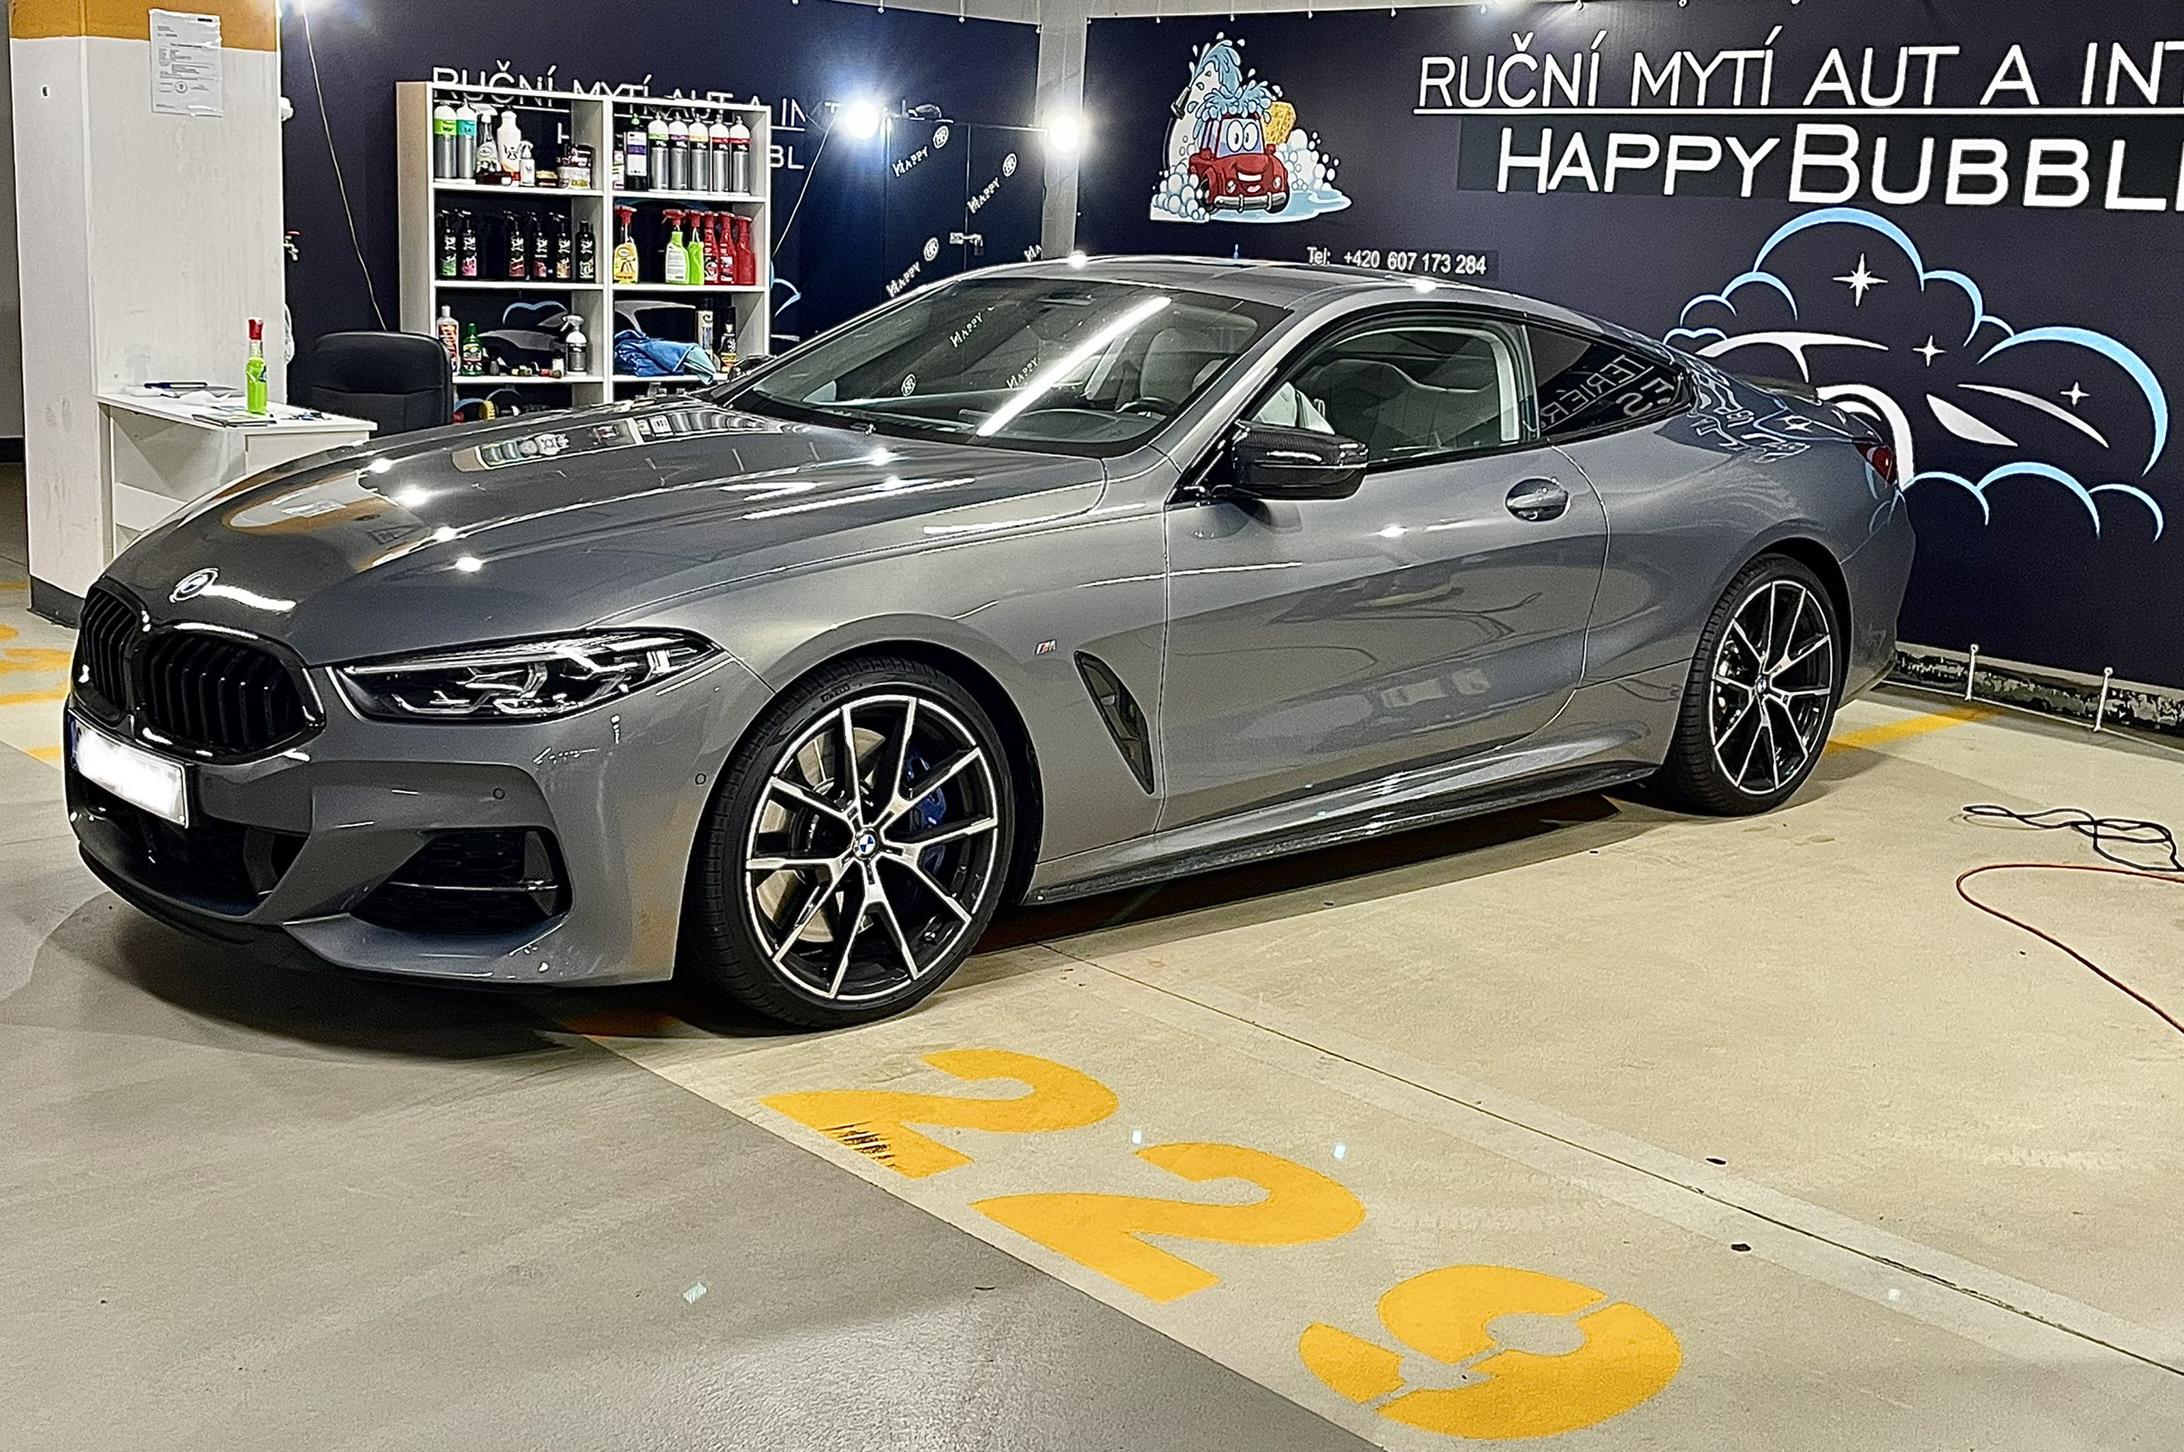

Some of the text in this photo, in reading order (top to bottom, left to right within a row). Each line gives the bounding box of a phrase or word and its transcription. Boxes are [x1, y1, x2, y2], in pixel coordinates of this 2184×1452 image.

[1419, 30, 1608, 107] RUČNÍ
[1630, 25, 1783, 106] MYTÍ
[1803, 46, 1960, 106] AUT
[1979, 45, 2040, 106] A
[1497, 123, 2184, 211] HAPPYBUBBL
[1306, 246, 1487, 275] Tel: +420 607 173 284
